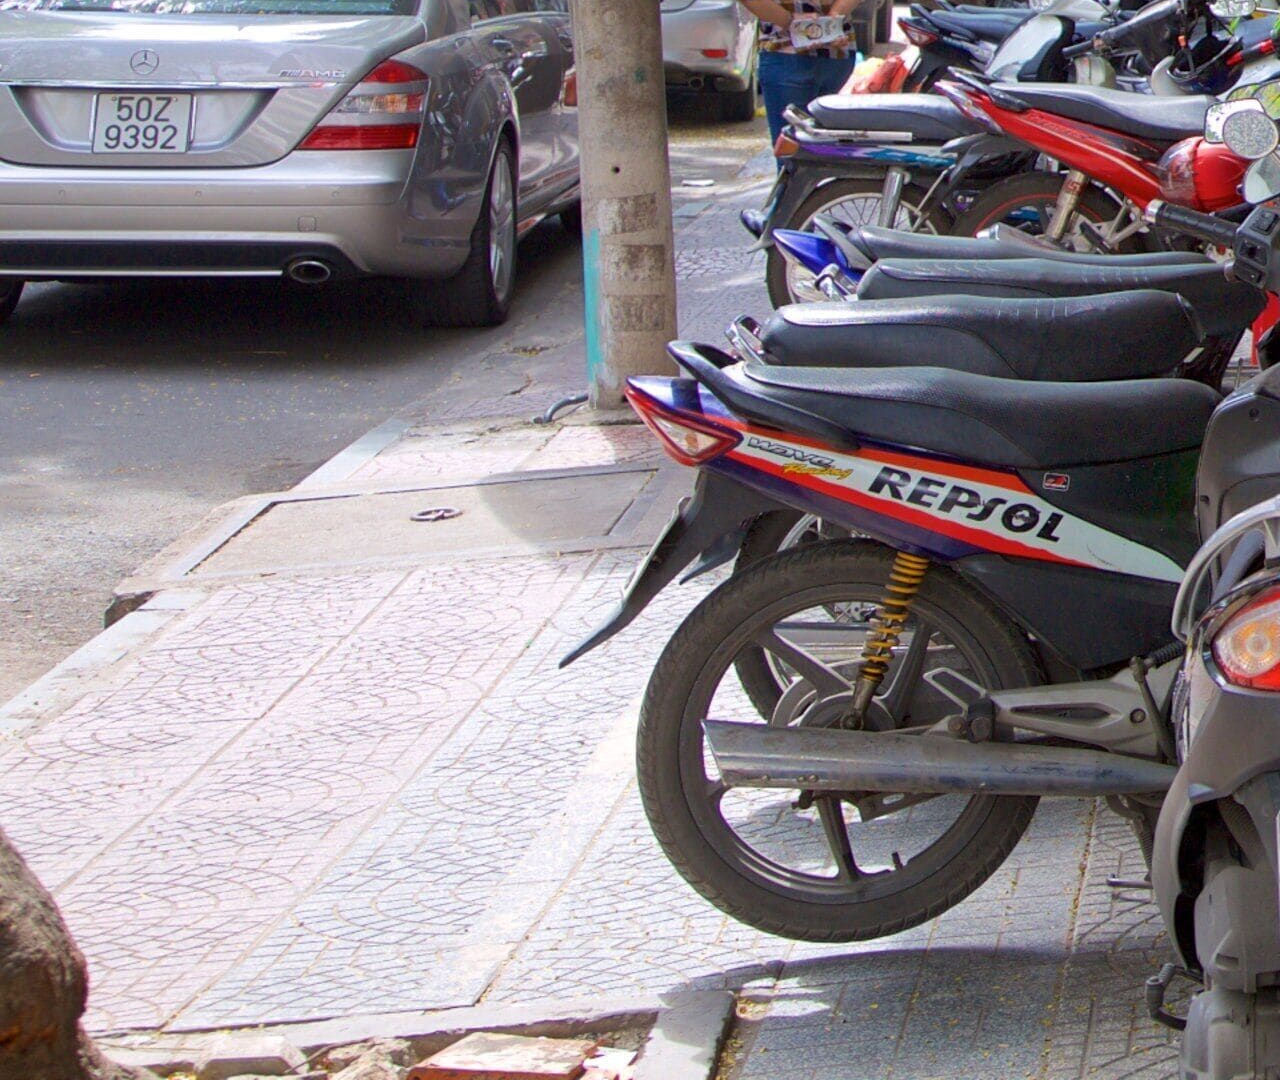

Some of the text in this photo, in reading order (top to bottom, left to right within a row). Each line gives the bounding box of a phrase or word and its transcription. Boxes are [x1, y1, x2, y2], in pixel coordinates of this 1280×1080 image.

[116, 96, 173, 122] 50Z
[104, 124, 178, 150] 9392
[867, 466, 1066, 543] REPSOL
